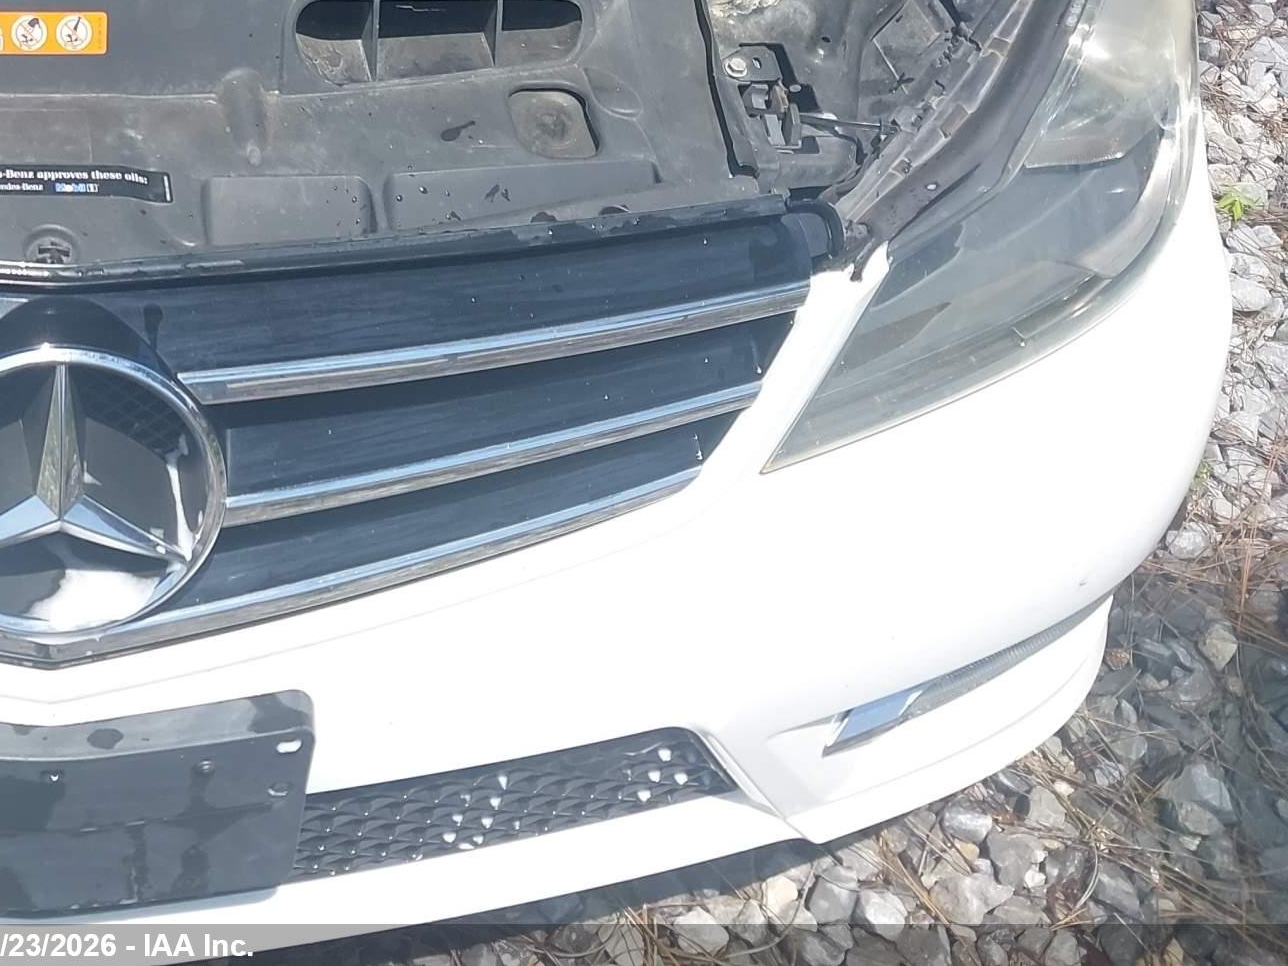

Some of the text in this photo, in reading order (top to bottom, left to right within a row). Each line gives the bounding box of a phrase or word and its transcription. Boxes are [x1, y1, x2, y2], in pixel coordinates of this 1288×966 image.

[36, 170, 88, 181] approves
[91, 170, 123, 180] these
[124, 172, 149, 185] oils:
